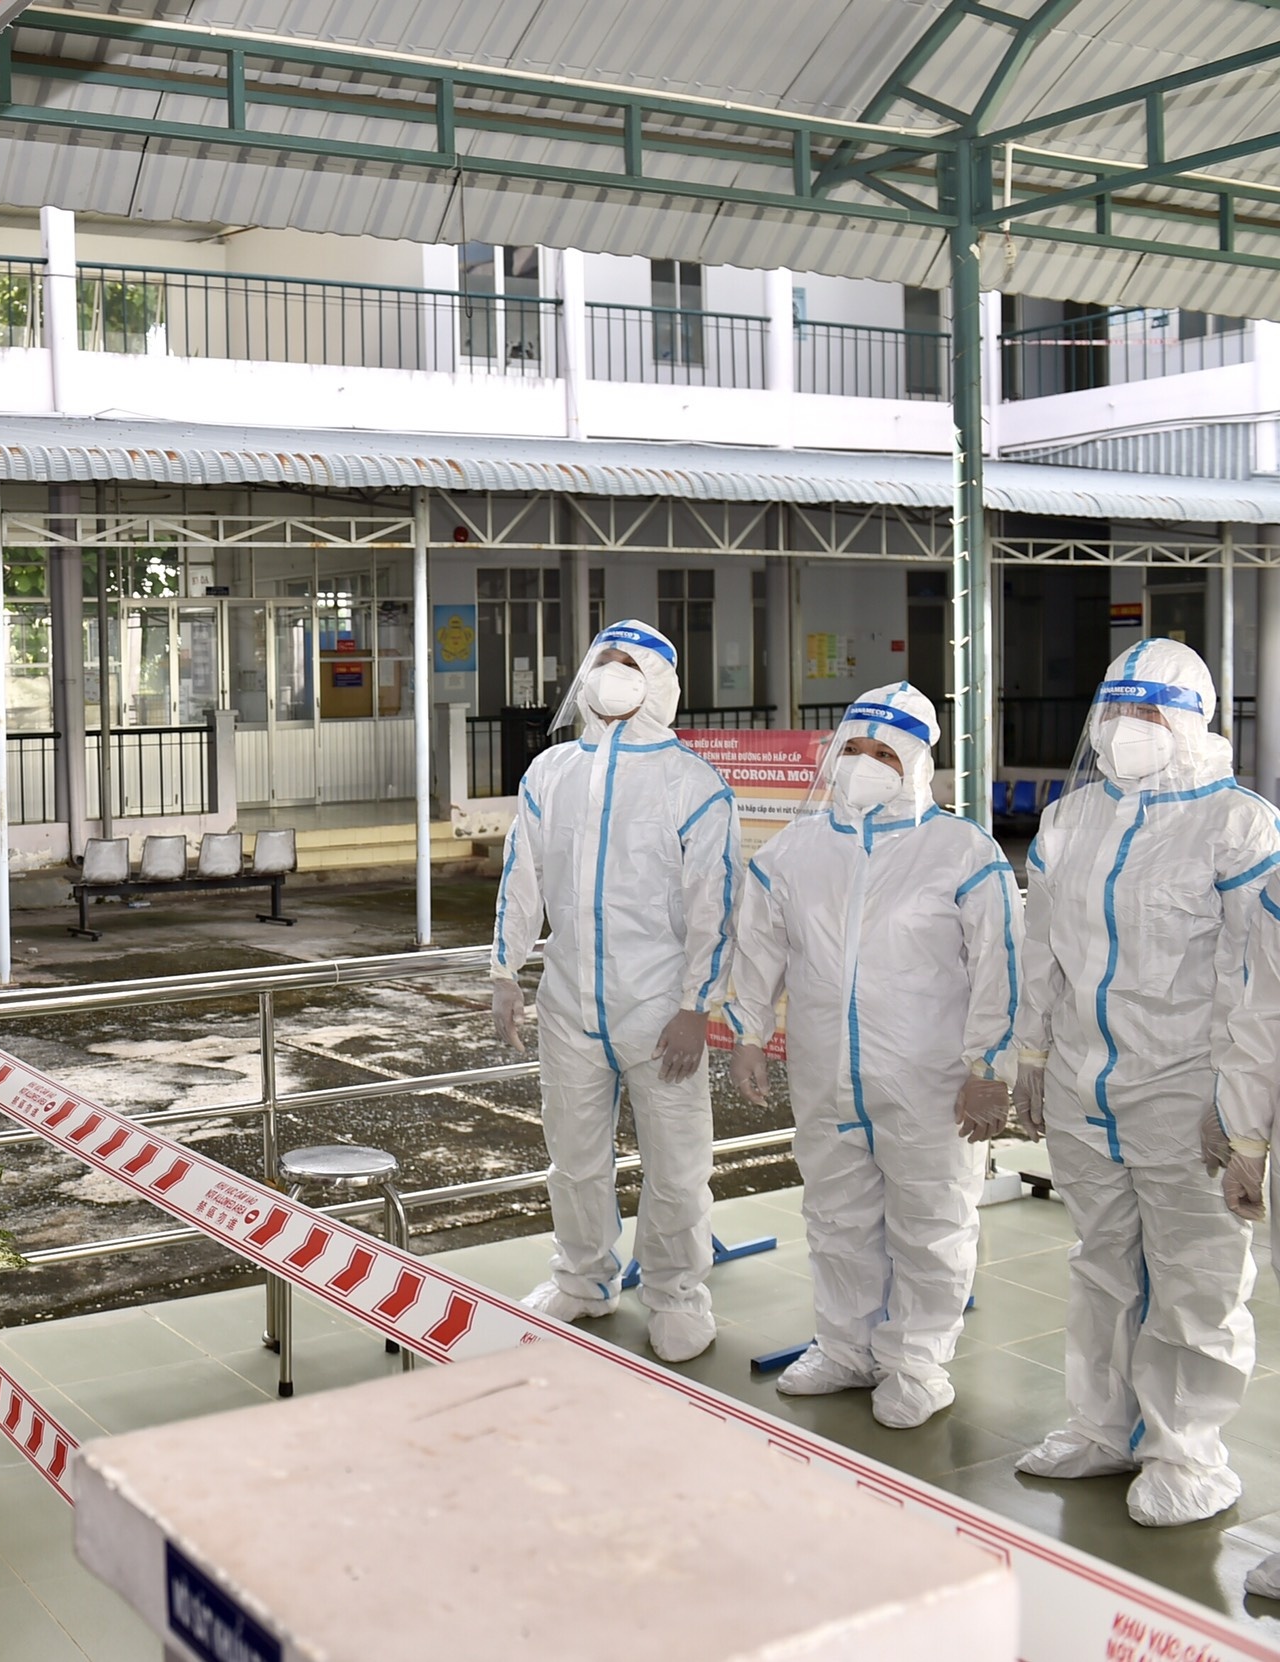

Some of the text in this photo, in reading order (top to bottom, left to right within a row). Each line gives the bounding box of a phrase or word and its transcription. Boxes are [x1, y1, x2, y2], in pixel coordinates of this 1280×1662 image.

[773, 751, 787, 762] HẤP
[788, 751, 802, 762] CẤP
[732, 768, 785, 781] CORONA
[787, 769, 815, 782] MỚI
[1112, 1611, 1147, 1643] KHU
